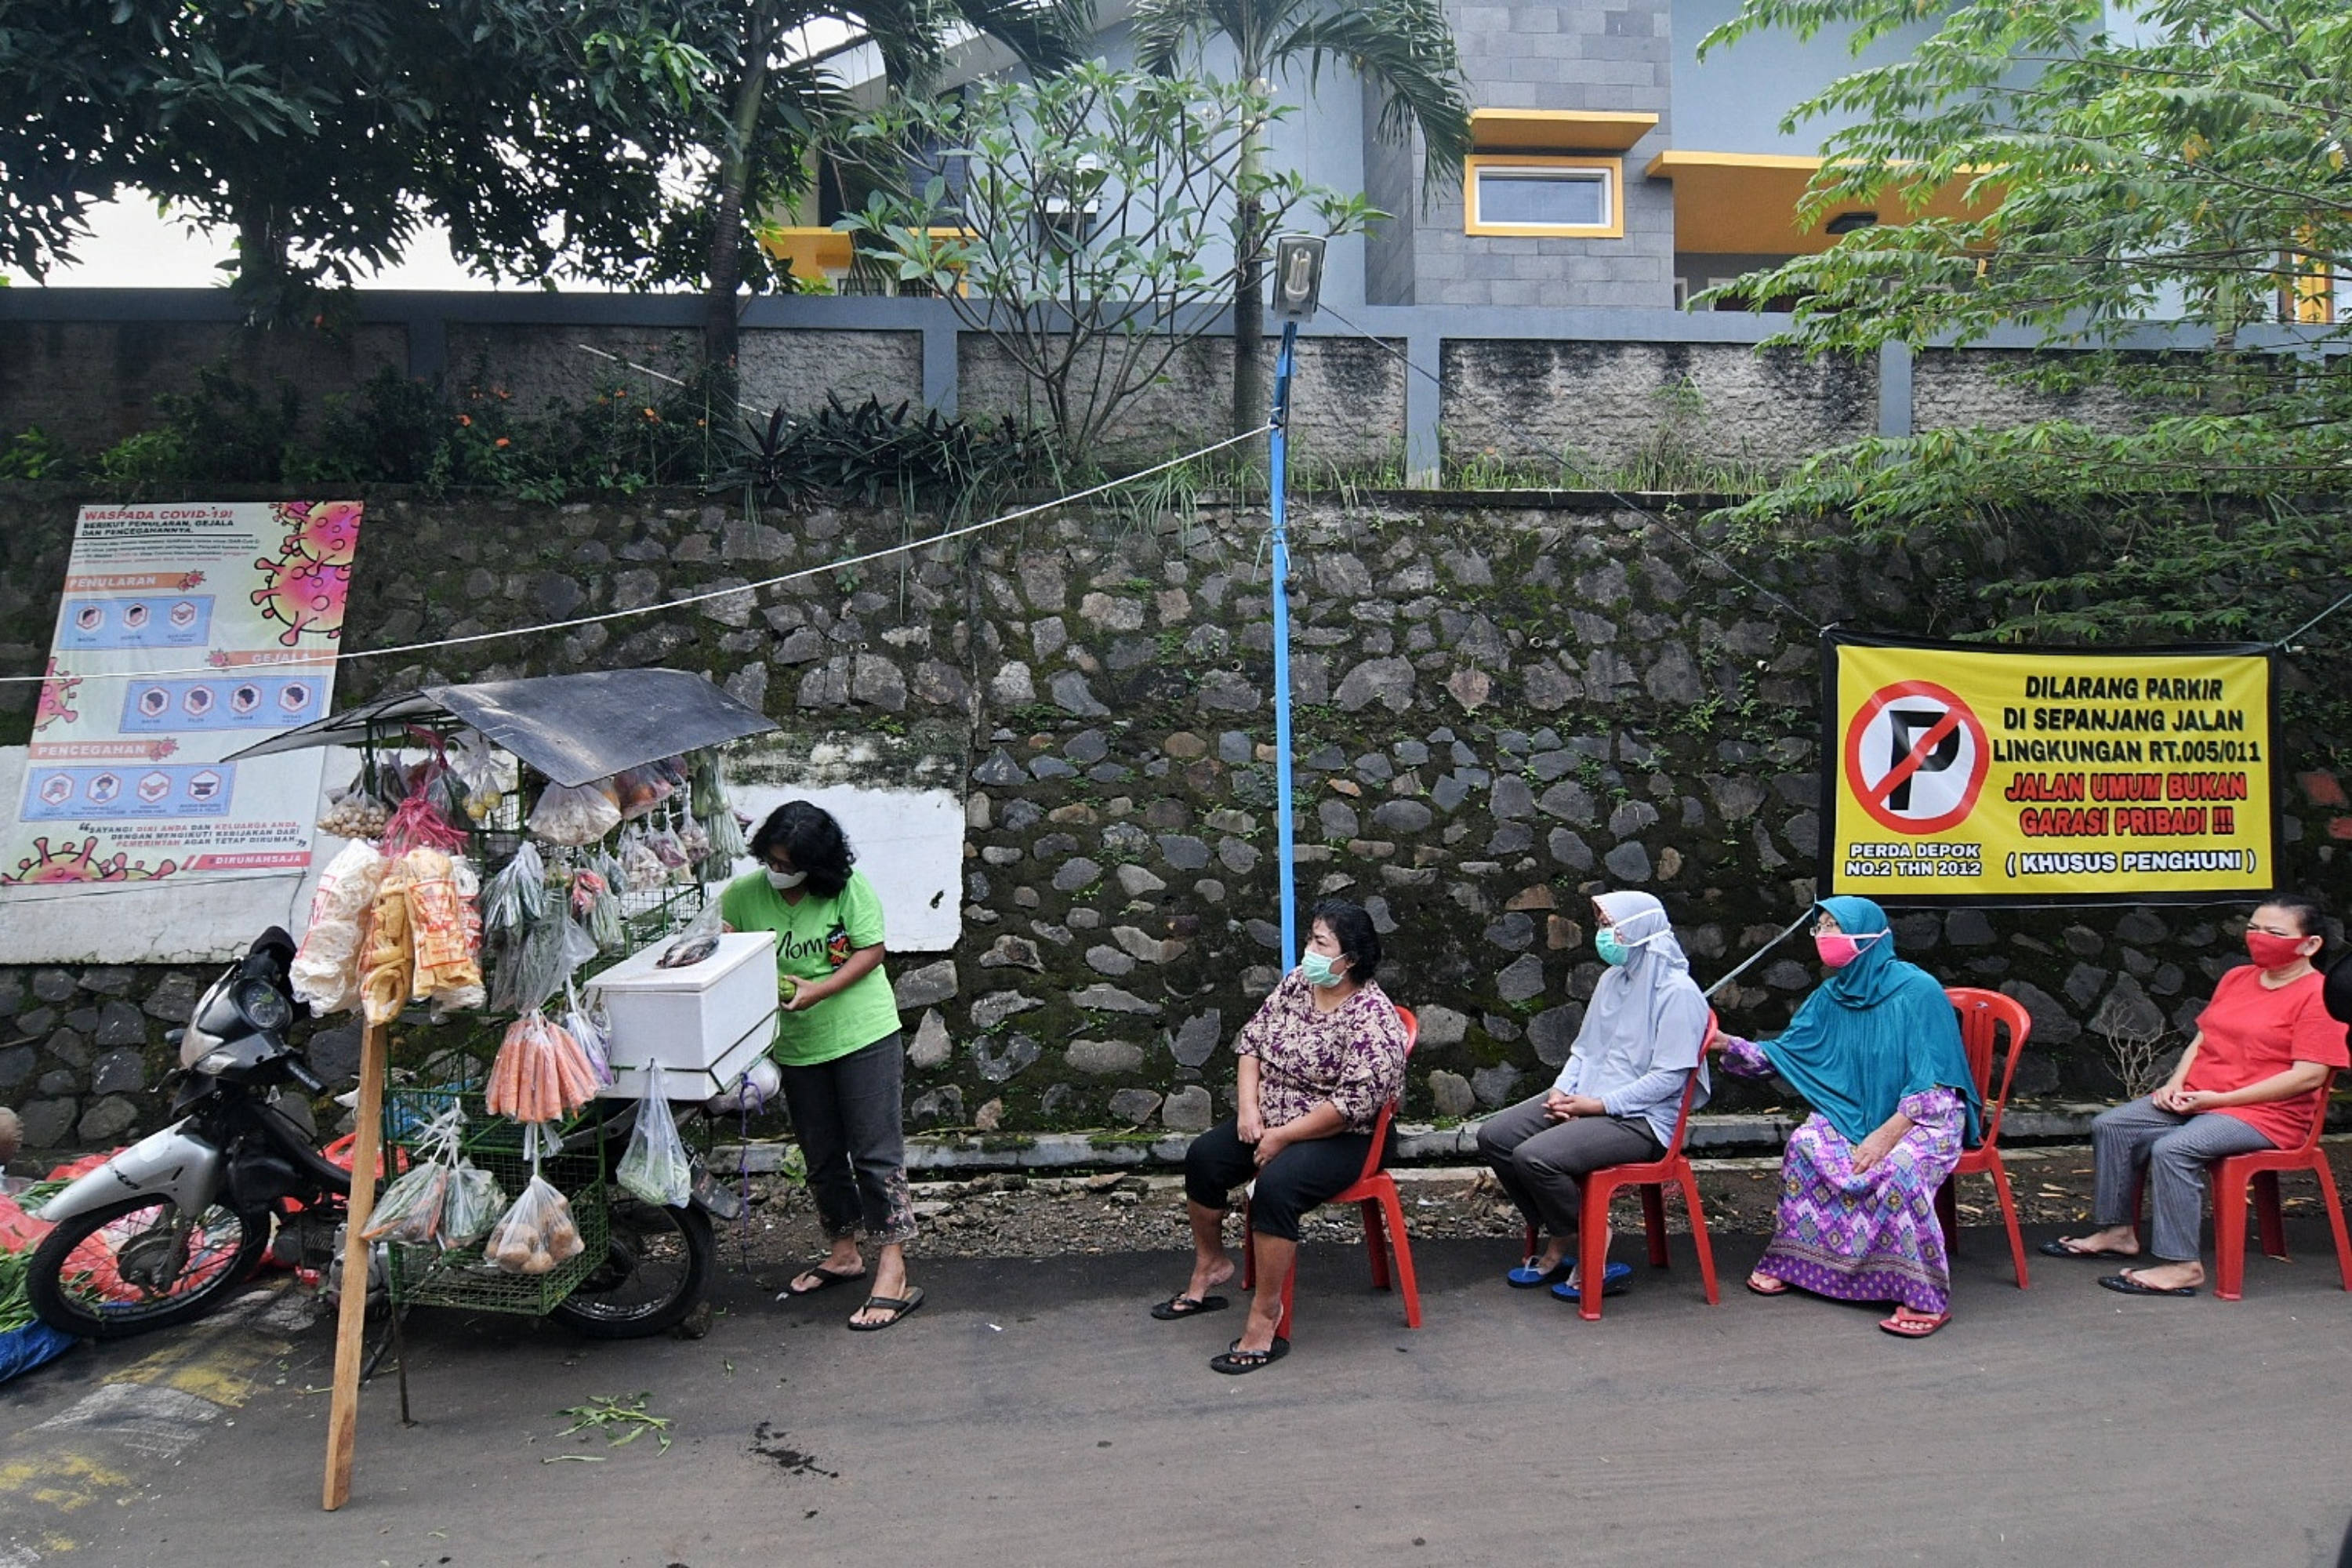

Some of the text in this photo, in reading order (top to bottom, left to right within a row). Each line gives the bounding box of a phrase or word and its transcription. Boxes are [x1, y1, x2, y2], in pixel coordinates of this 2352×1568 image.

[85, 510, 234, 521] WASPADA COVID-19!
[69, 576, 156, 588] PENULARAN
[252, 652, 309, 664] GEJALA
[2025, 675, 2223, 701] DILARANG PARKIR
[2004, 707, 2244, 731] DI SEPANJANG JALAN
[38, 745, 145, 756] PENCEGAHAN
[1993, 739, 2262, 763] LINGKUNGAN RT.005/011
[2005, 771, 2247, 801] JALAN UMUM BUKAN
[2020, 807, 2108, 836] GARASI
[2114, 806, 2207, 836] PRIBADI
[1850, 842, 1981, 858] PERDA DEPOK
[1846, 860, 1981, 876] NO.2 THN 2012
[2021, 852, 2118, 874] KHUSUS
[2122, 849, 2242, 873] PENGHUNI
